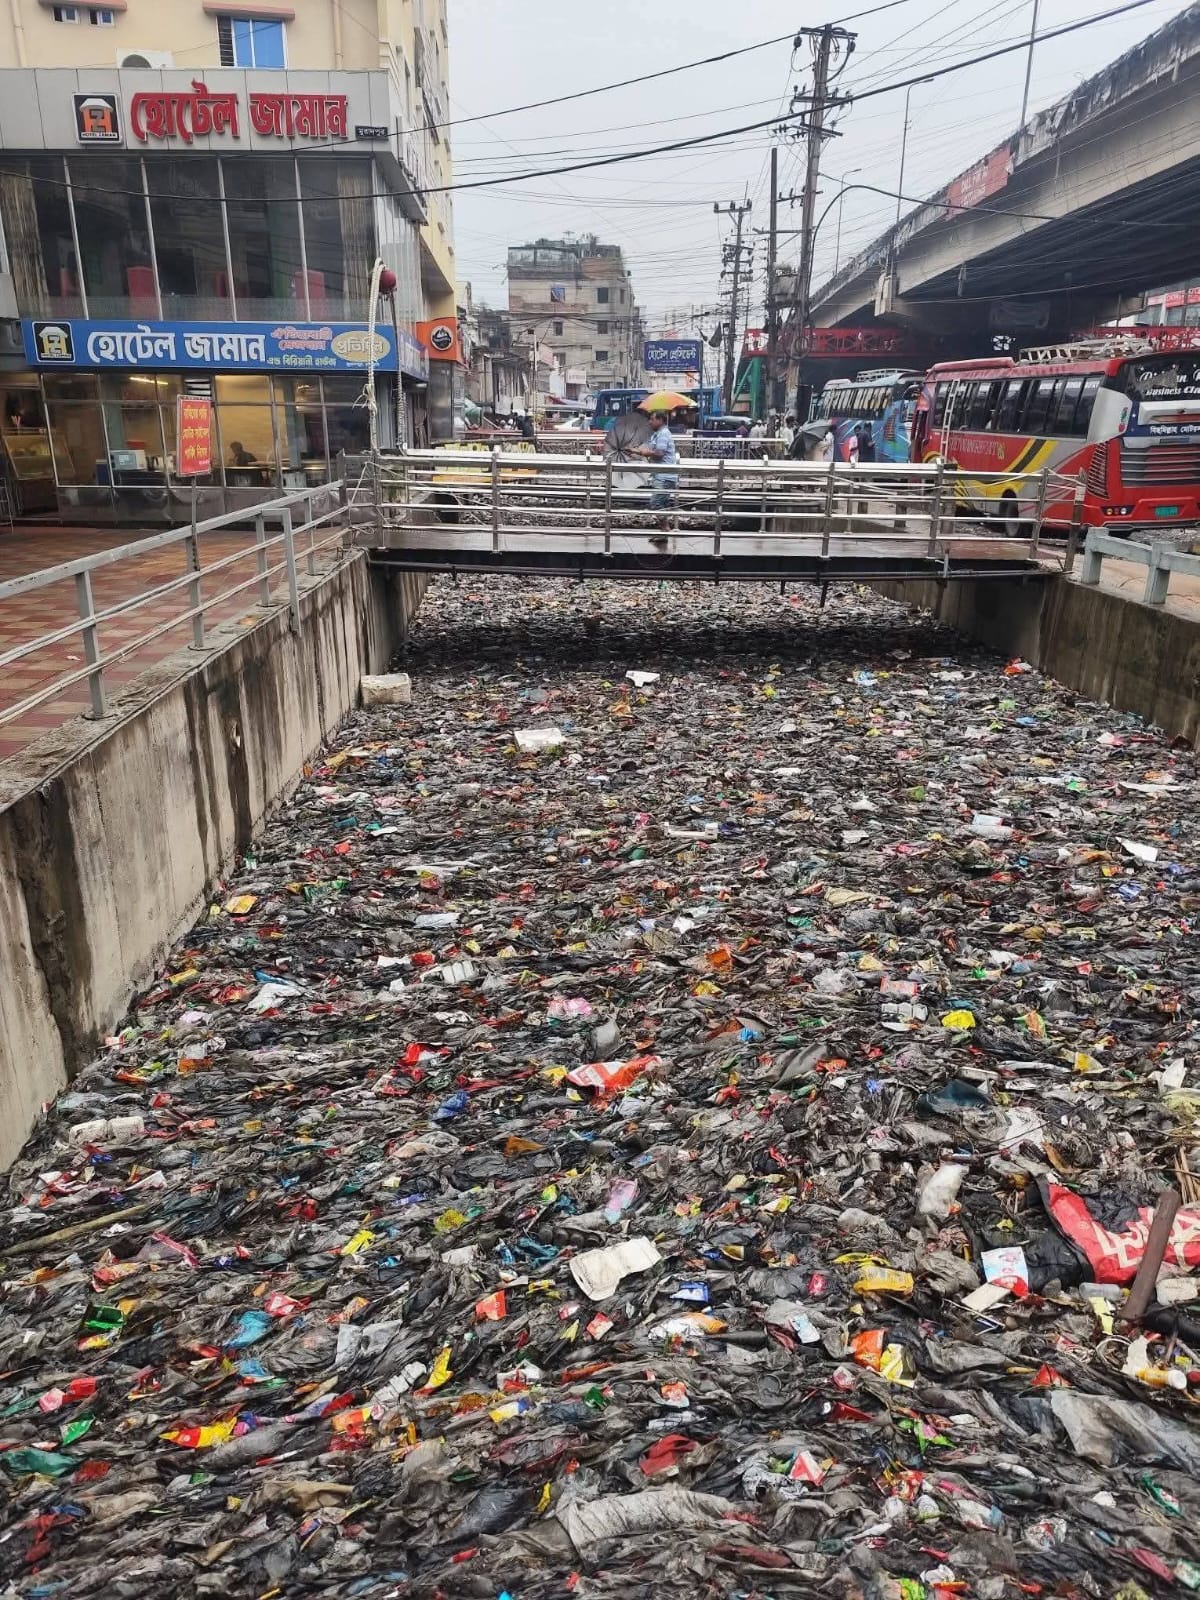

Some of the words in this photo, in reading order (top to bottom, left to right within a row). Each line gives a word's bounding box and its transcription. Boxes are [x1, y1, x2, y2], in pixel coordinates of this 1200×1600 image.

[131, 80, 238, 143] হোটেল
[249, 93, 347, 138] জামান
[87, 324, 176, 364] হোটেল
[183, 333, 265, 361] জামান
